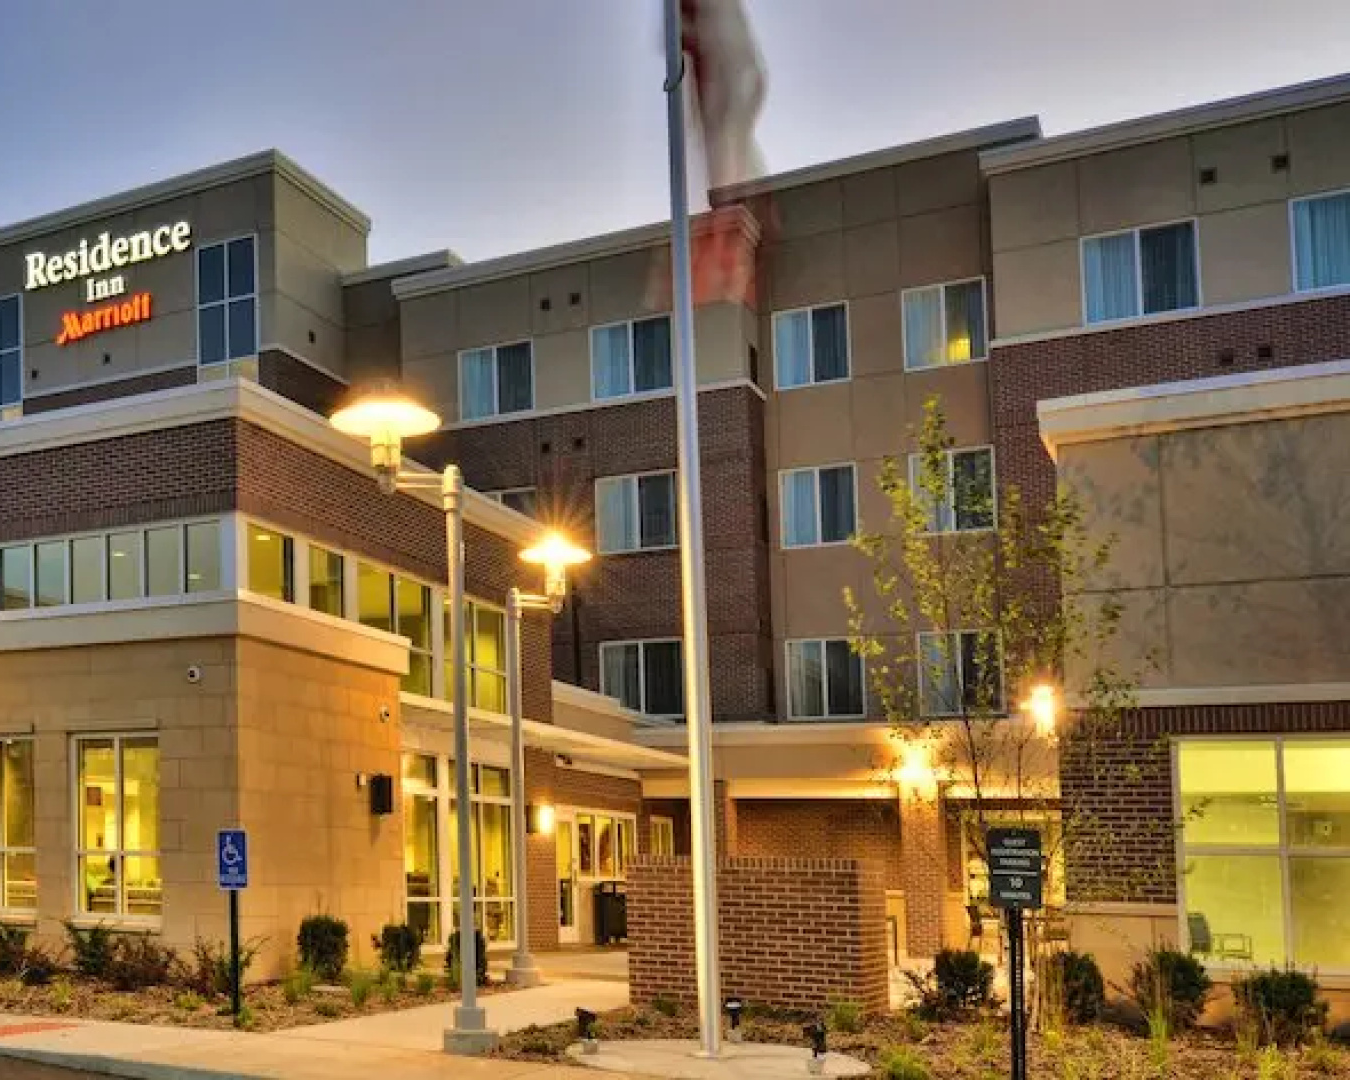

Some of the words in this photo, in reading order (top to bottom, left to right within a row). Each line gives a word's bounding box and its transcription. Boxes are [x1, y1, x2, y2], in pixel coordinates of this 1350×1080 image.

[24, 221, 192, 290] Residence
[86, 275, 125, 303] Inn
[55, 292, 152, 346] Marriott
